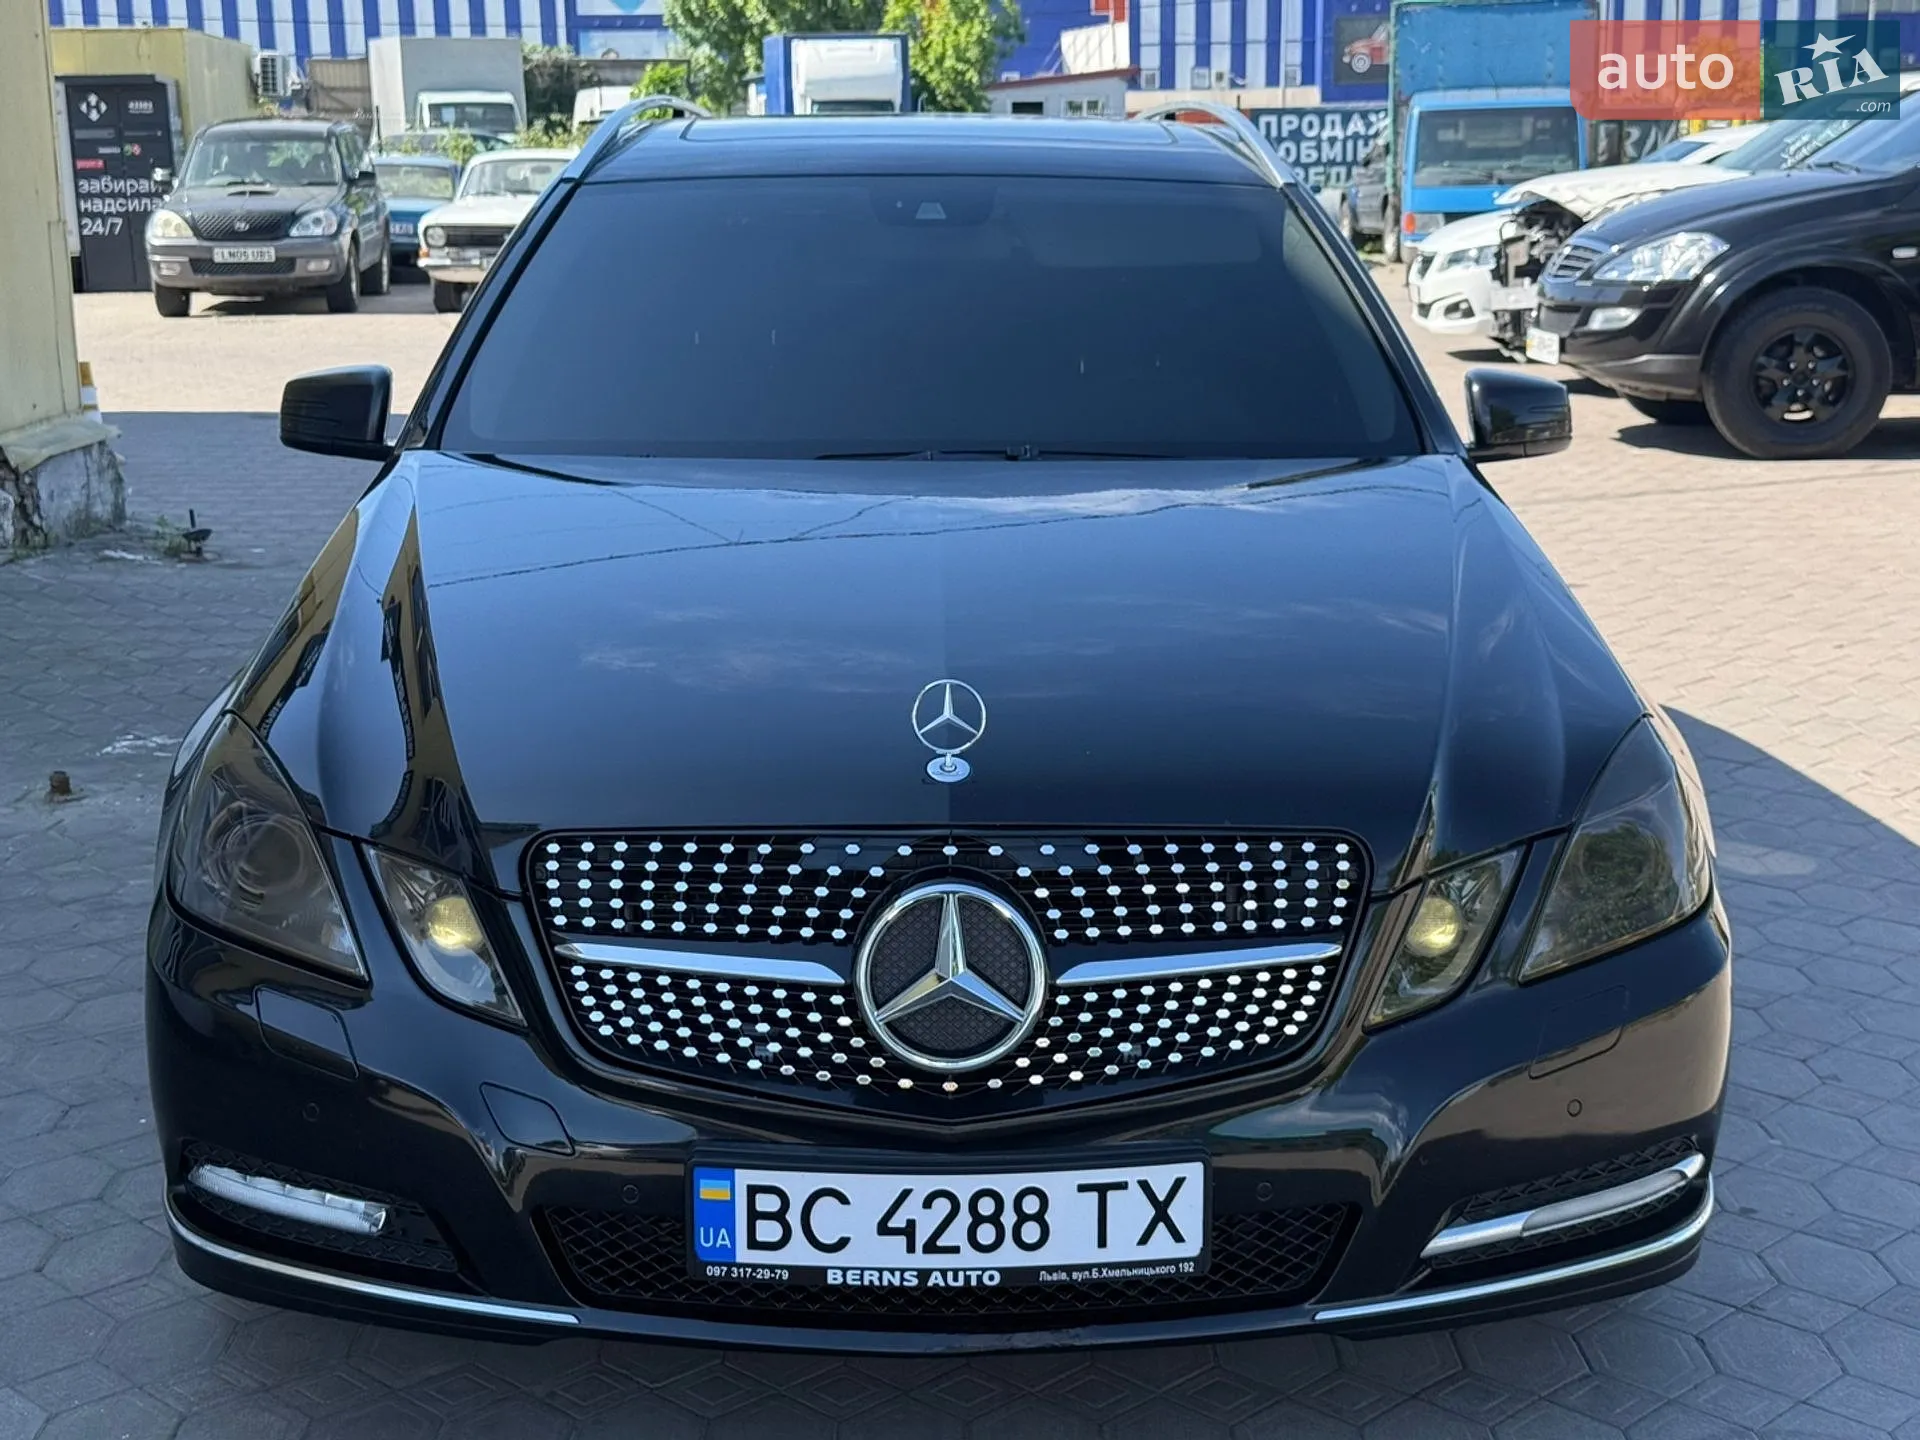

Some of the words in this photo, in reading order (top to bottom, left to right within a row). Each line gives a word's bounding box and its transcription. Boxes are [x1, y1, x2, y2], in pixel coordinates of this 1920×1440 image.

[80, 217, 122, 236] 24/7
[745, 1183, 852, 1254] BC
[876, 1184, 1051, 1255] 4288
[1076, 1175, 1188, 1250] TX
[699, 1227, 732, 1249] UA
[706, 1265, 727, 1277] 097
[730, 1267, 789, 1280] 317-29-79
[1178, 1261, 1195, 1273] 192
[826, 1268, 919, 1287] BERNS
[927, 1269, 1001, 1287] AUTO
